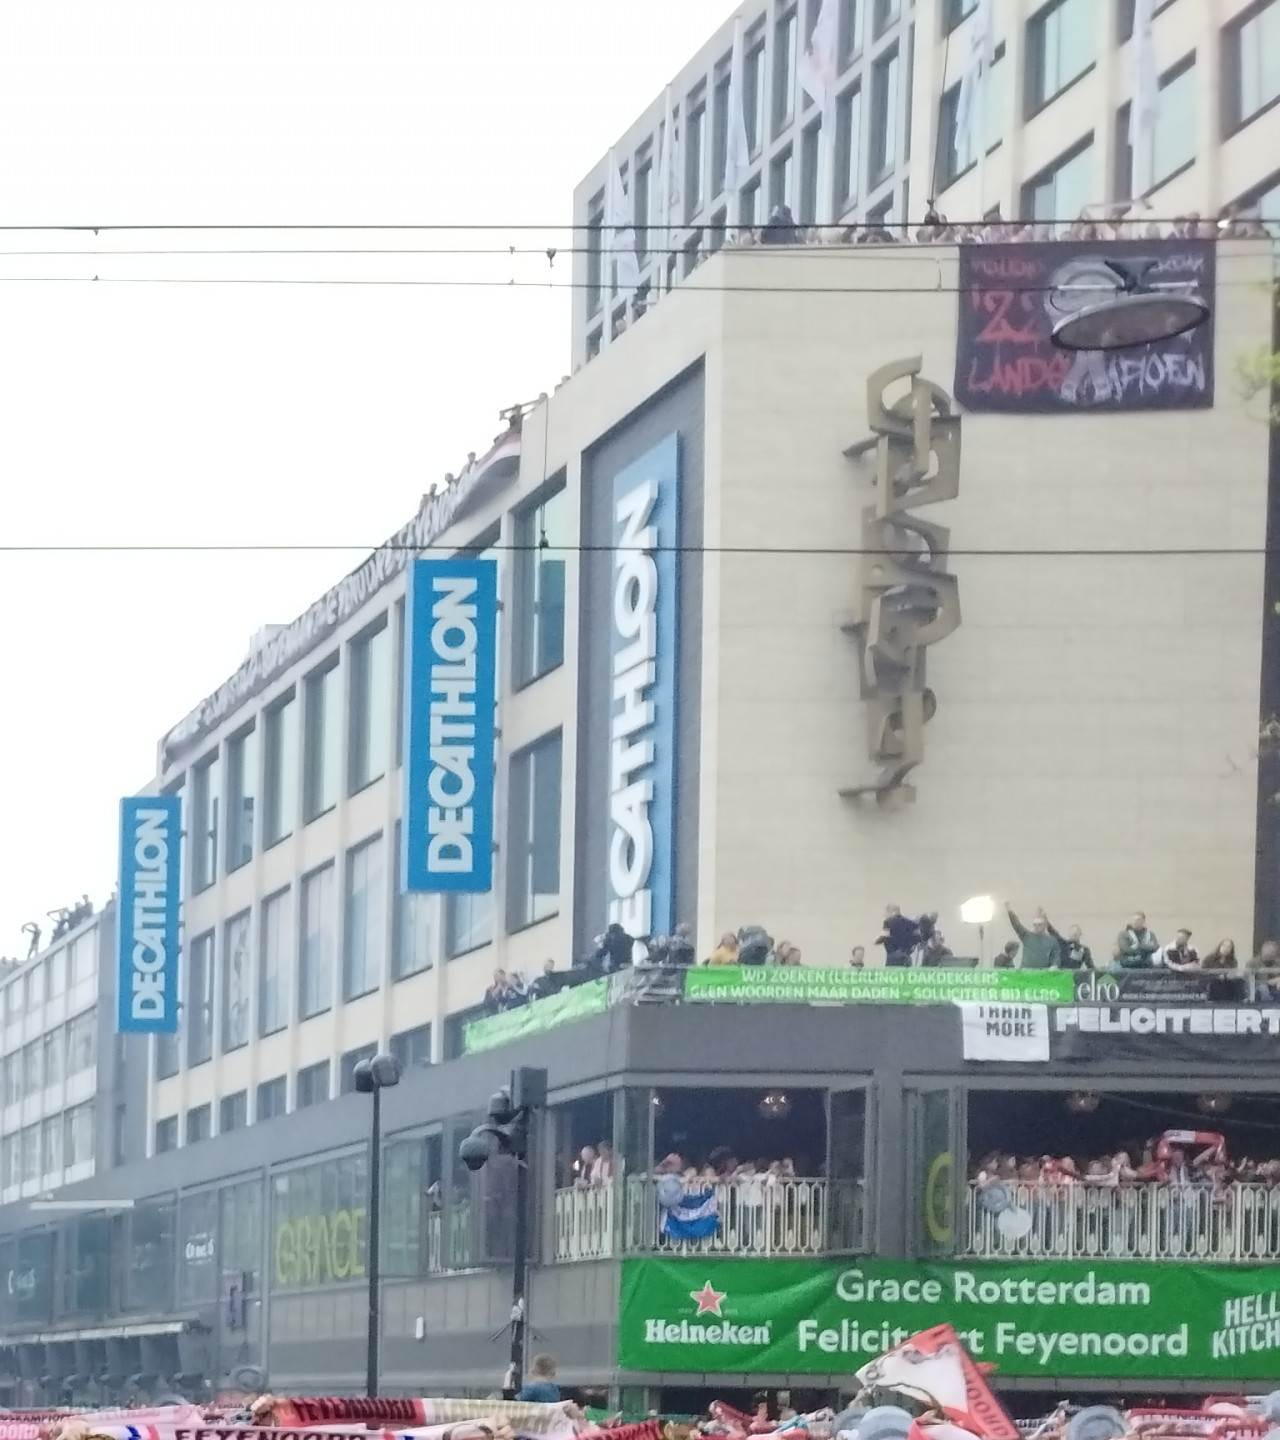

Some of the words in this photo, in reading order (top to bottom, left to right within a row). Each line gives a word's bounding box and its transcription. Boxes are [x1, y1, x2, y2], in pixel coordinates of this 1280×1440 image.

[428, 576, 477, 874] DECATHLON
[131, 808, 169, 1020] DECATHLON
[986, 1021, 1037, 1038] MORE
[1055, 1006, 1280, 1034] FELICITEERT
[275, 1206, 366, 1285] GRACE
[835, 1269, 942, 1302] Grace
[953, 1270, 1151, 1306] Rotterdam
[644, 1319, 771, 1345] Heineken
[798, 1318, 985, 1354] Felicitrt
[995, 1321, 1189, 1366] Feyenoord
